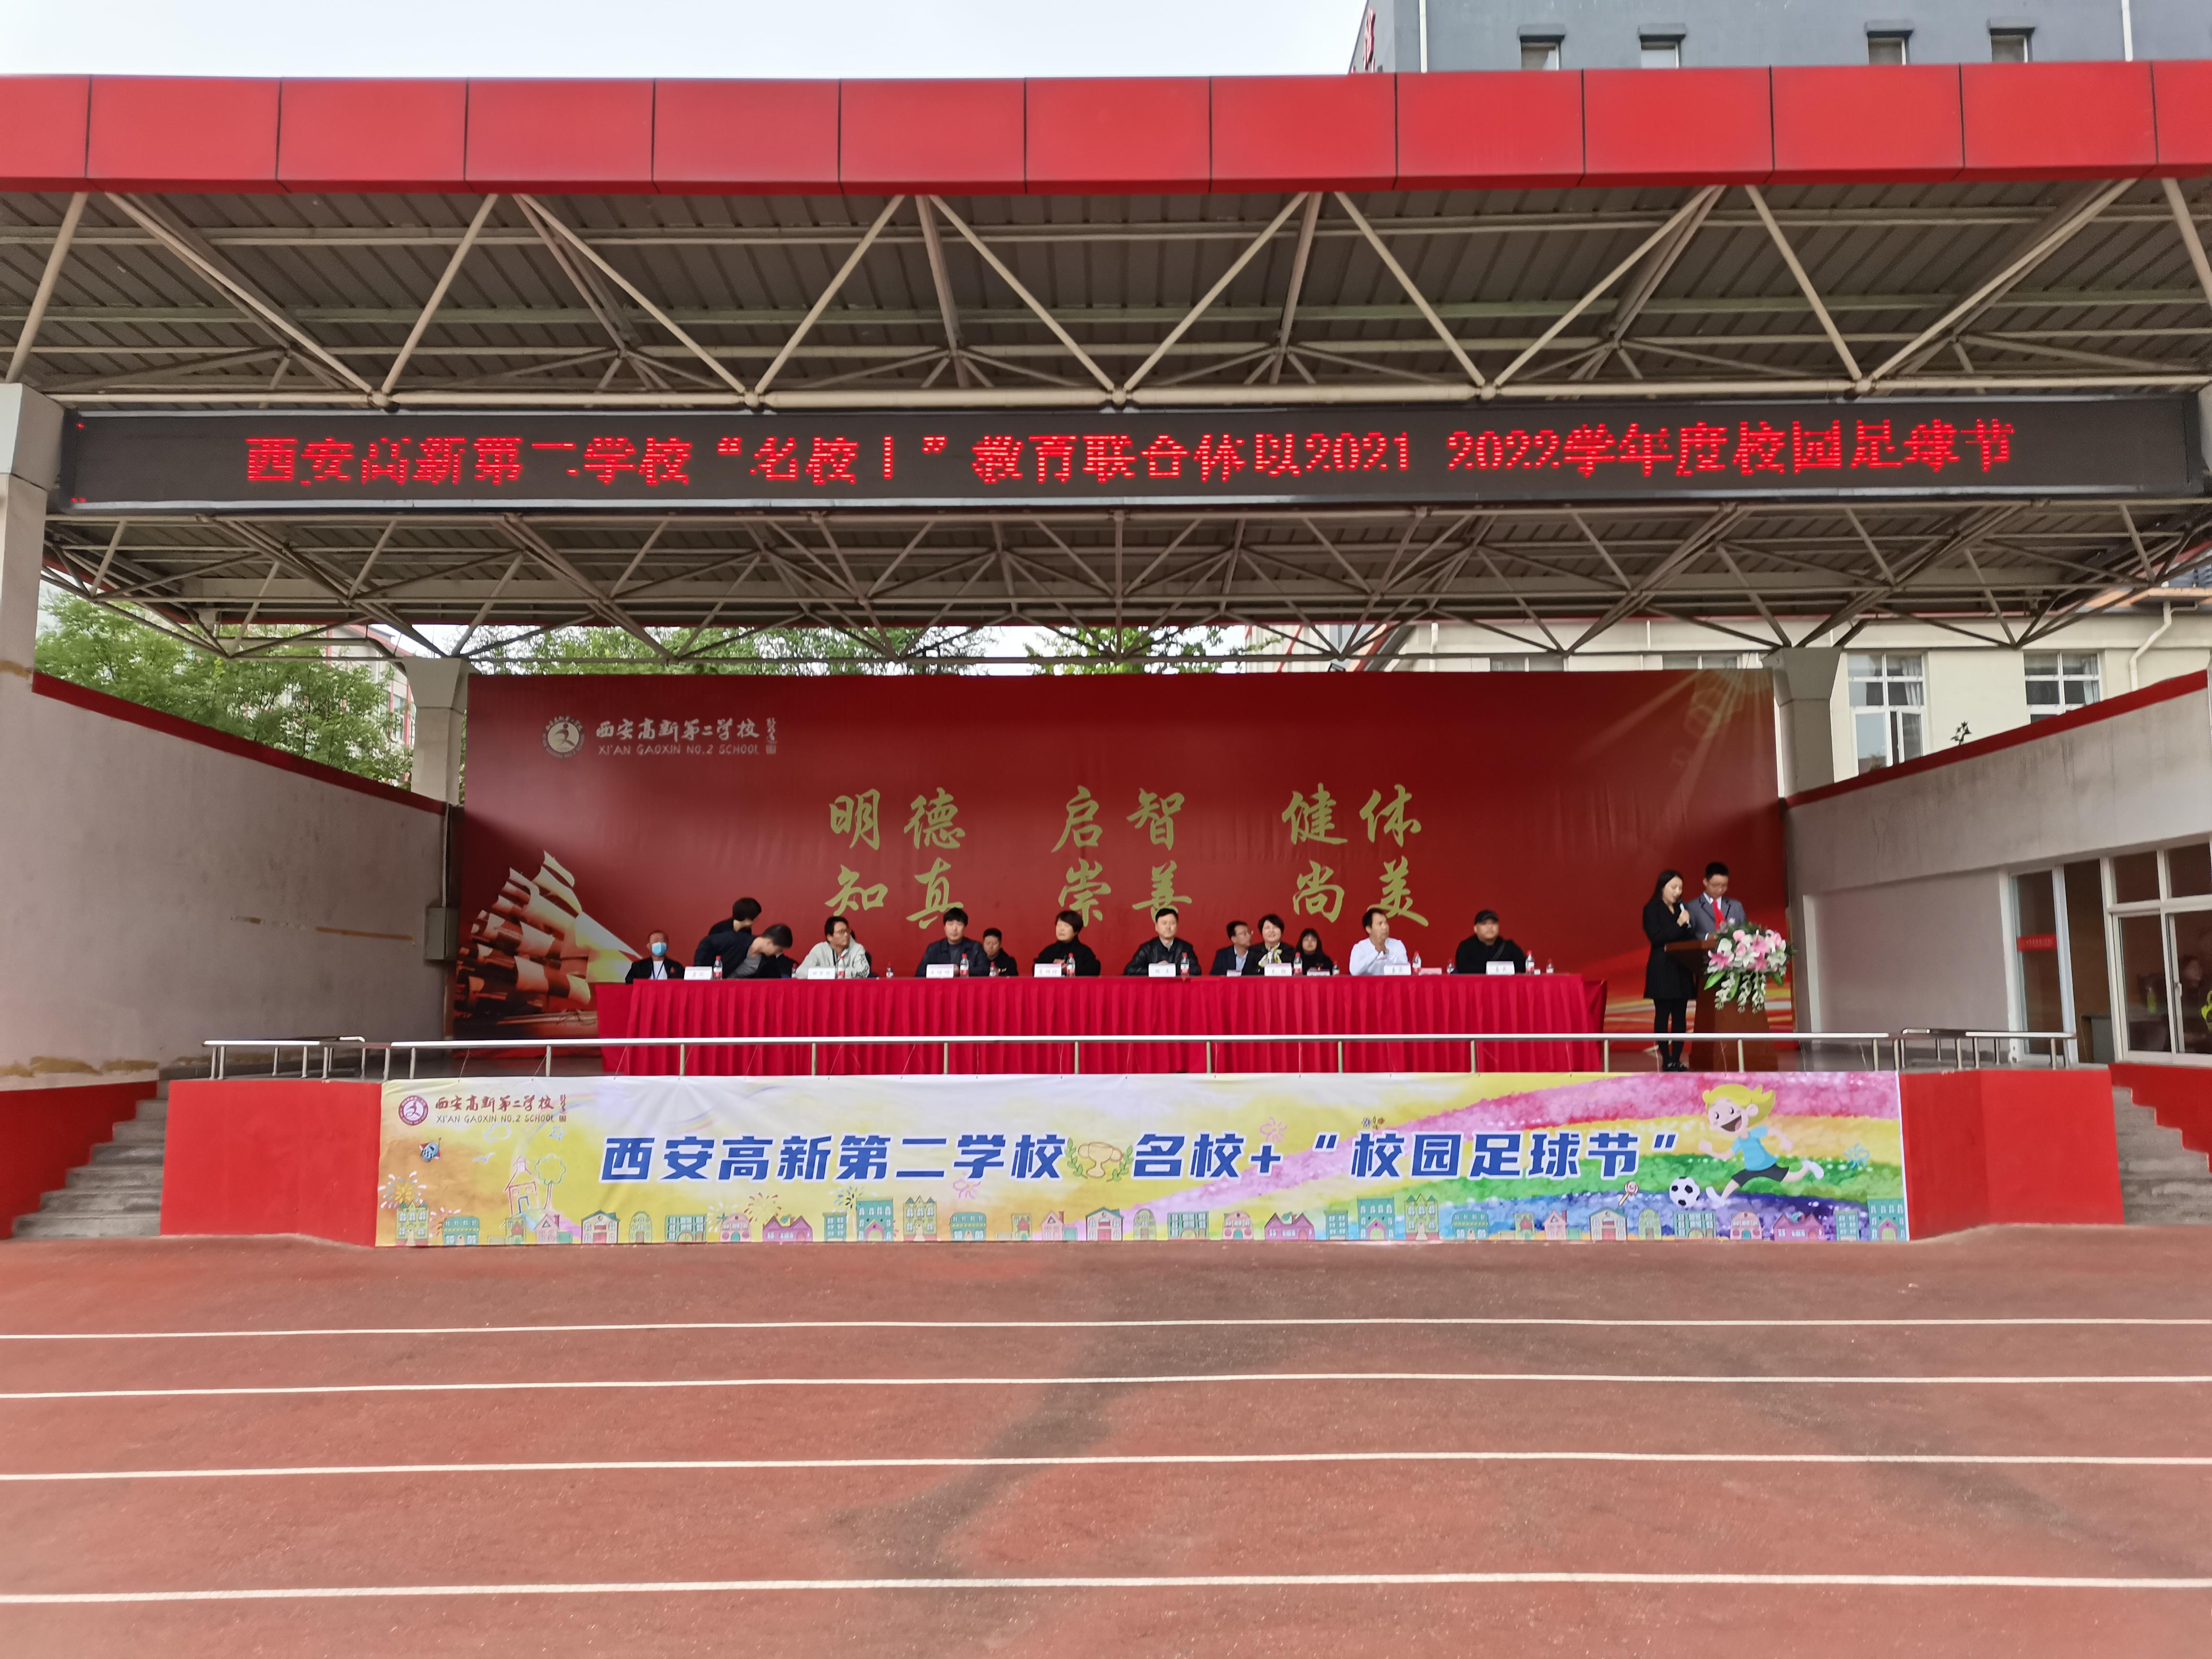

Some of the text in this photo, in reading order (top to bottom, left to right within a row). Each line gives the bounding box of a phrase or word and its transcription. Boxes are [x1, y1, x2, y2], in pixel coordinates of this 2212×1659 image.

[596, 718, 759, 742] 西安高新第二学校
[599, 744, 759, 756] XI'AN GAOXIN NO.2 SCHOOL
[829, 783, 1421, 853] 明德 启智 健体
[825, 856, 1429, 929] 知真 崇善 尚美
[435, 1095, 554, 1113] 西安高新第二学校
[436, 1114, 554, 1123] XI'AN GAOXIN NO.2 SCHOOL
[601, 1134, 1063, 1181] 西安高新第二学校
